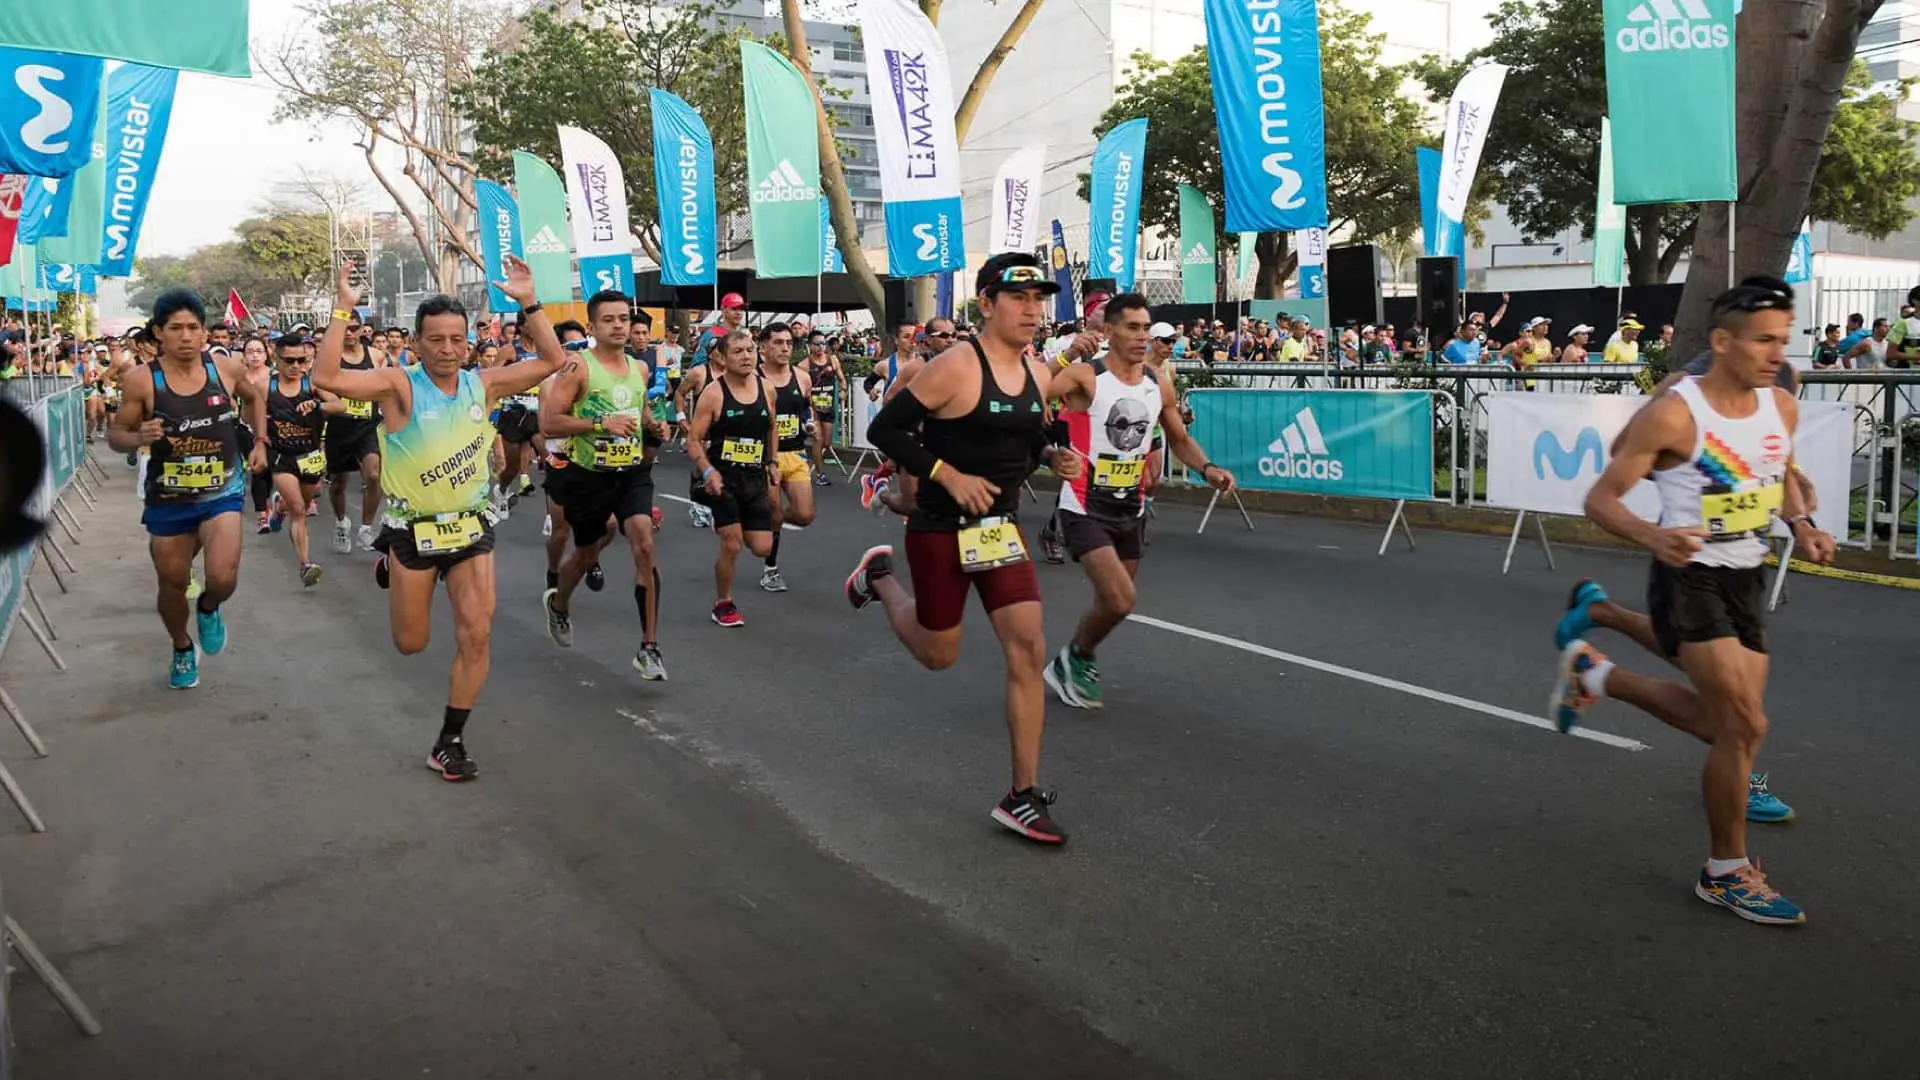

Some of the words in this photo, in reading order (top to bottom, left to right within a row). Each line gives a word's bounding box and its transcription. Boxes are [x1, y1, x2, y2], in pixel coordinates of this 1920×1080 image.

[1616, 19, 1729, 52] adidas
[111, 95, 152, 222] movistar
[679, 134, 699, 240] movistar
[752, 184, 816, 203] adidas
[1110, 152, 1133, 243] movistar
[938, 212, 950, 268] movistar
[610, 446, 632, 456] 393
[733, 444, 756, 455] 1533
[175, 464, 213, 475] 2544
[449, 462, 477, 490] PERU
[1110, 462, 1137, 475] 1737
[1258, 453, 1343, 480] adidas
[1721, 493, 1758, 514] 243
